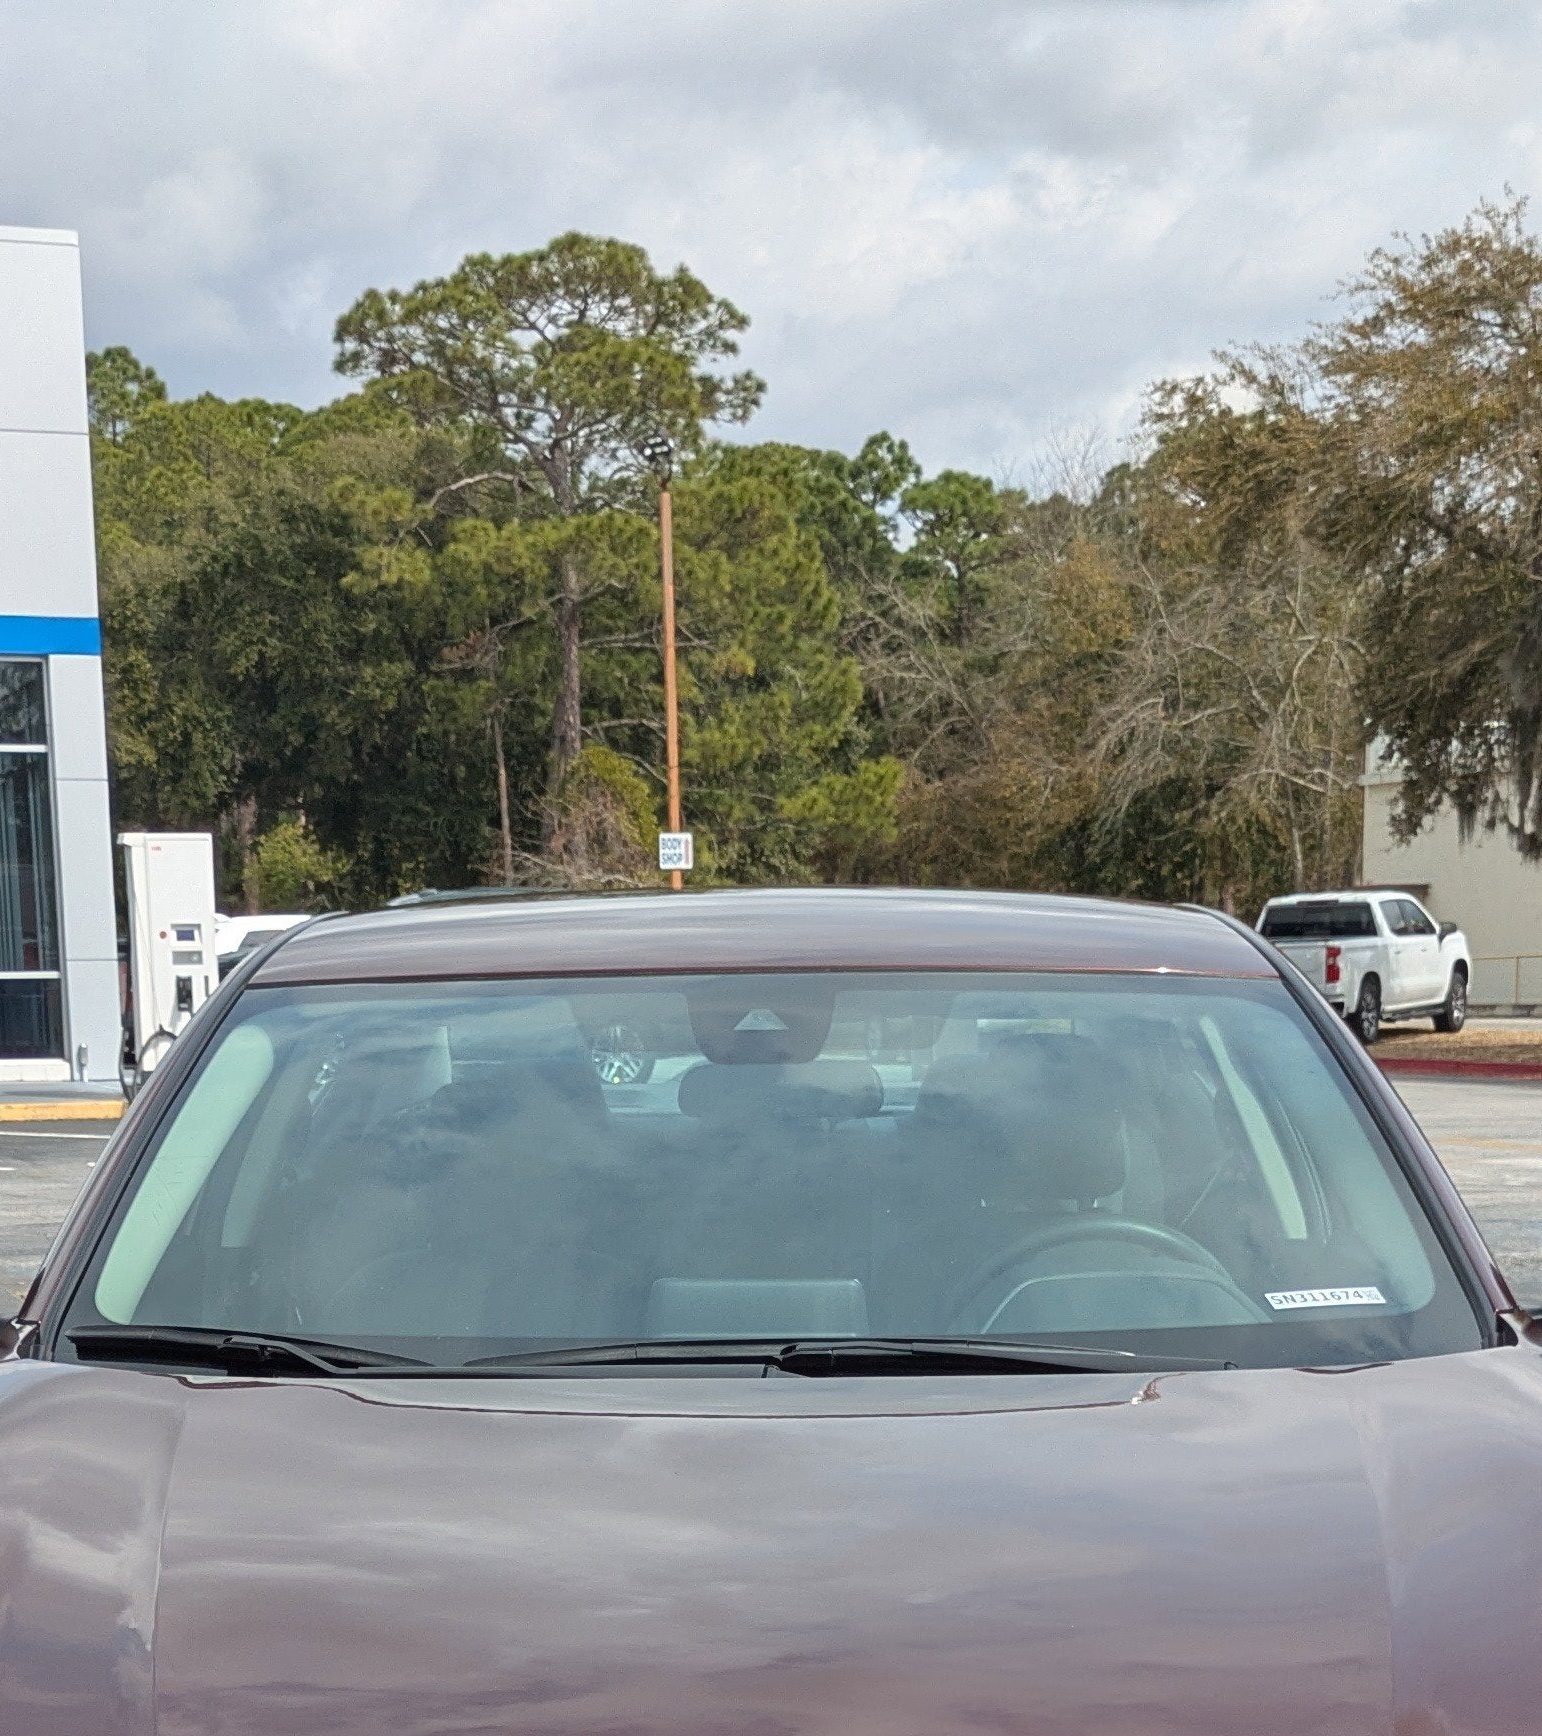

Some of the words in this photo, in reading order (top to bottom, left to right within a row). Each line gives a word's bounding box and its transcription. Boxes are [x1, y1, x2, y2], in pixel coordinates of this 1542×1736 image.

[661, 837, 682, 850] BODY
[661, 853, 682, 865] SHOP
[1270, 1290, 1364, 1305] SN311674
